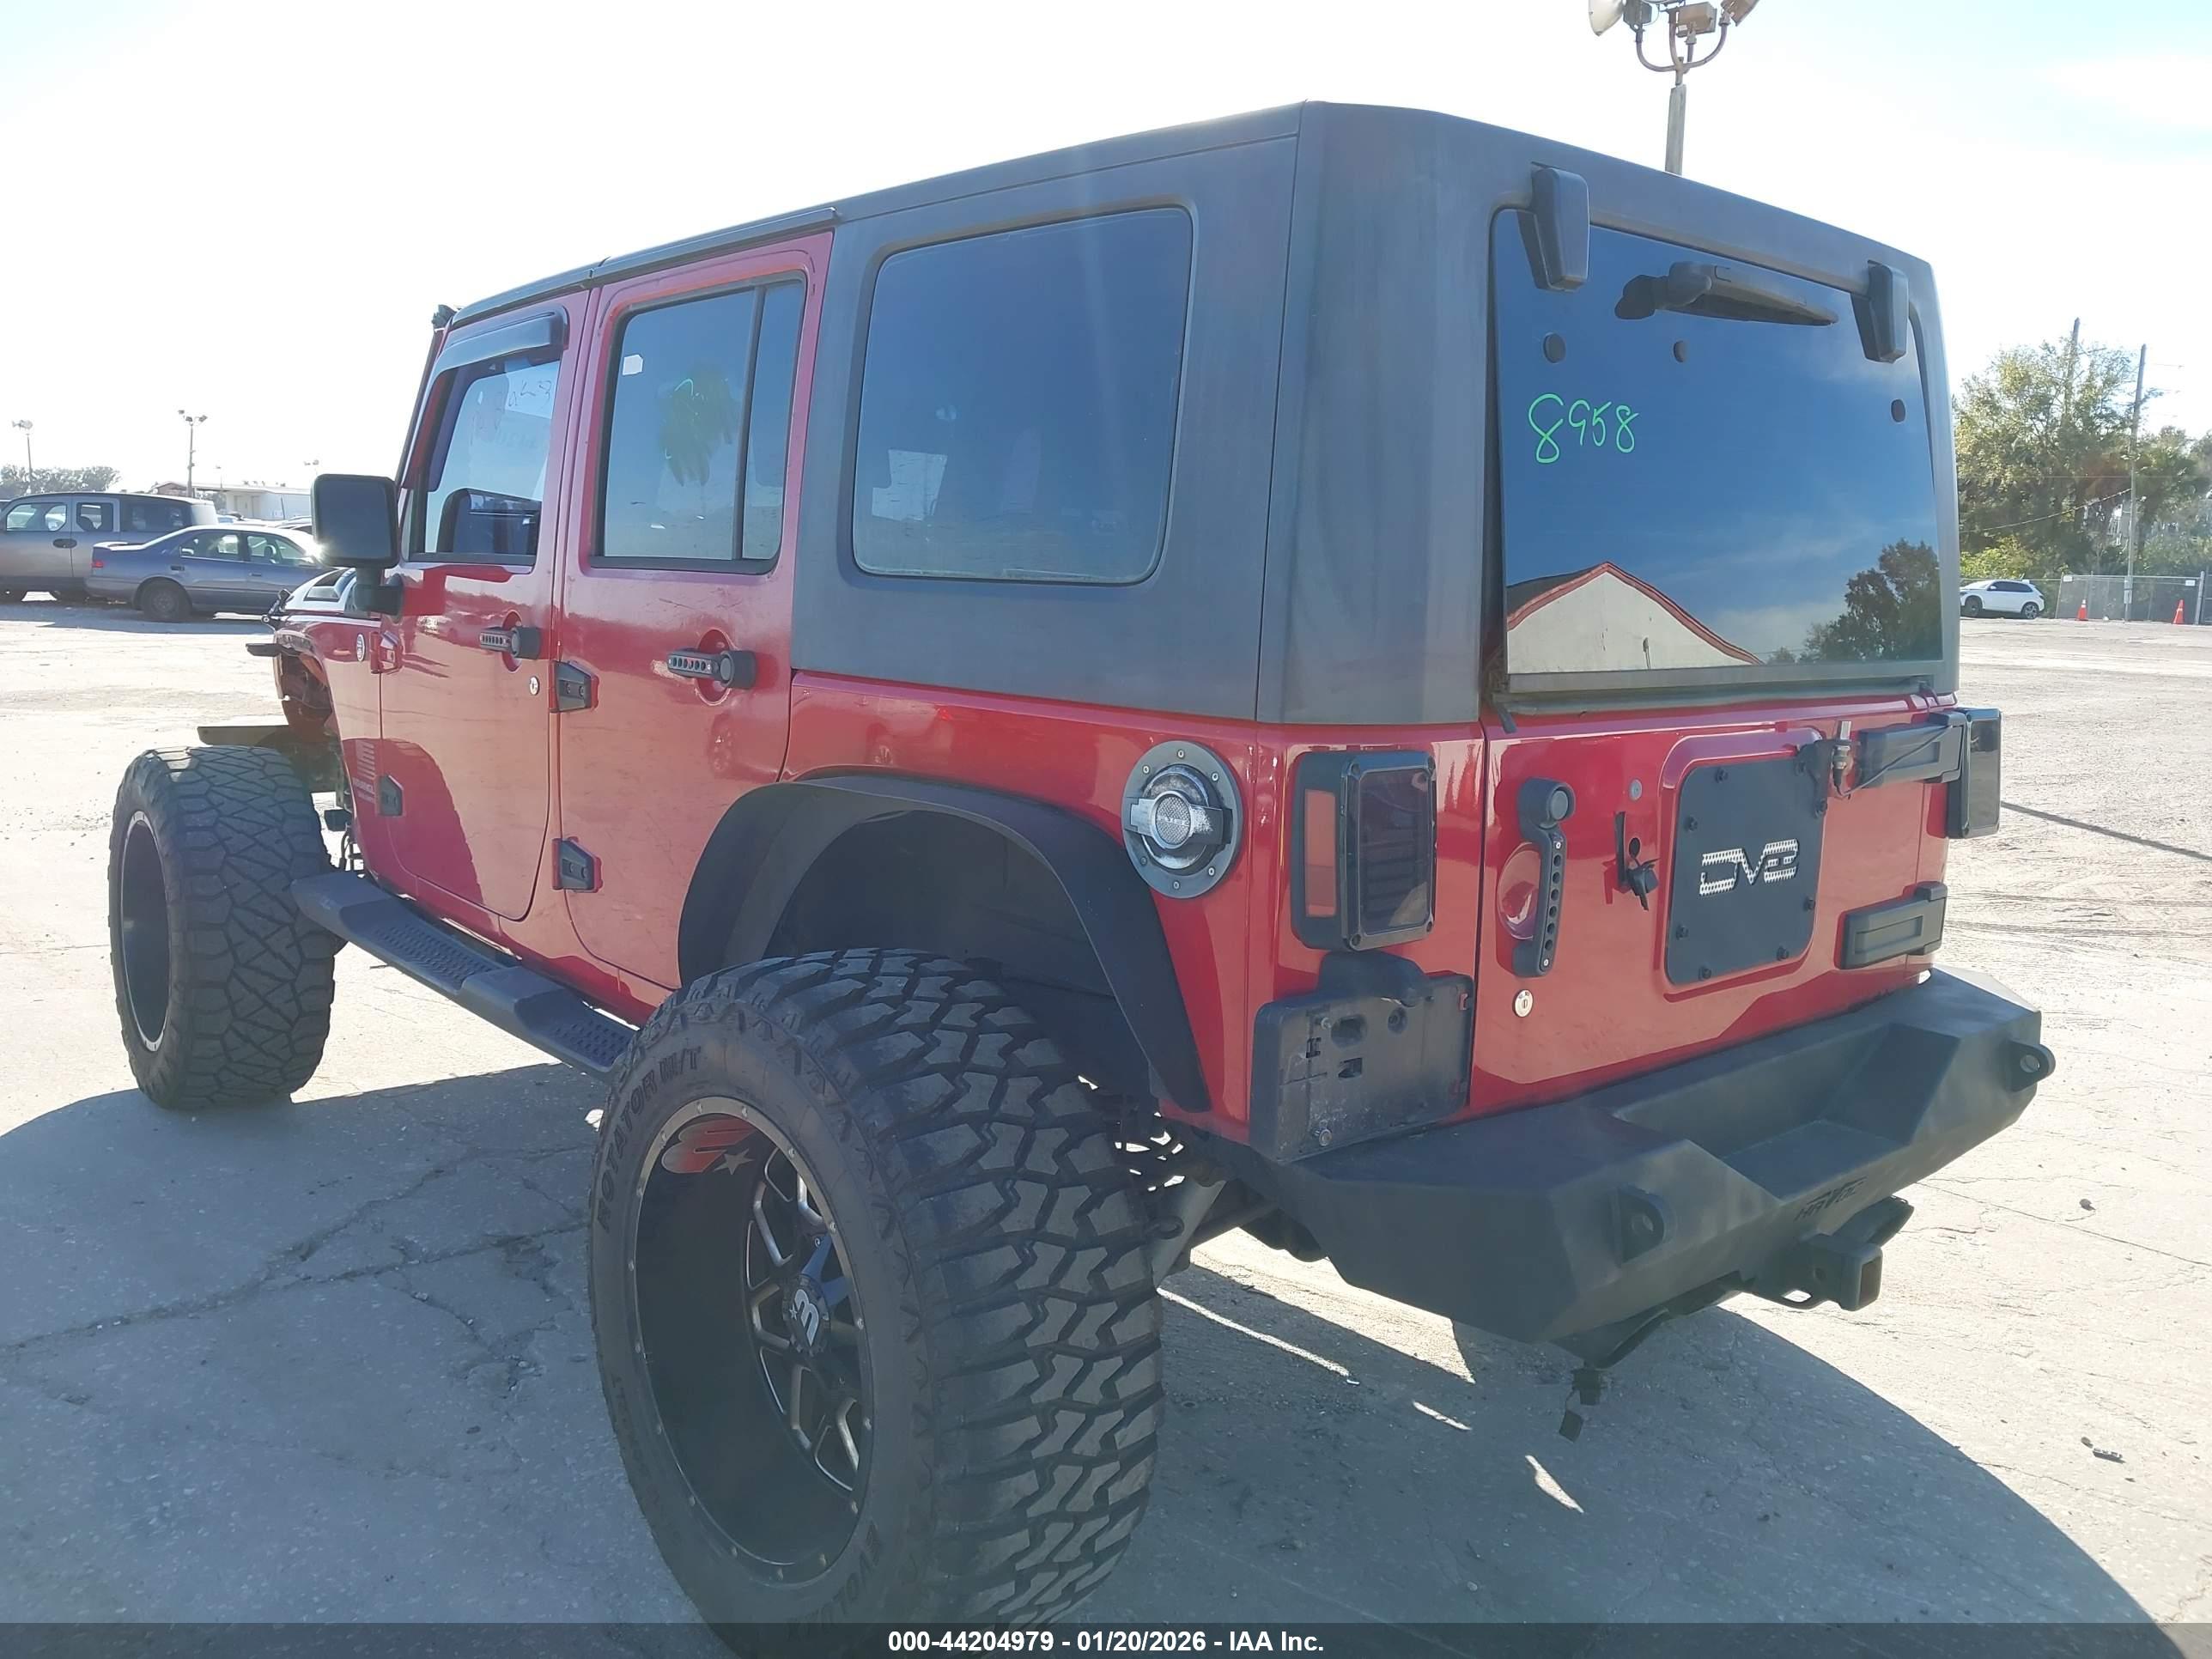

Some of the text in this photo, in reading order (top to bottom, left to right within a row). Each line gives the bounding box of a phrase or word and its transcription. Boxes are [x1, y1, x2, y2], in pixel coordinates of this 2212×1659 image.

[1528, 392, 1640, 465] 8958
[596, 1045, 702, 1234] ROTATOR M/T
